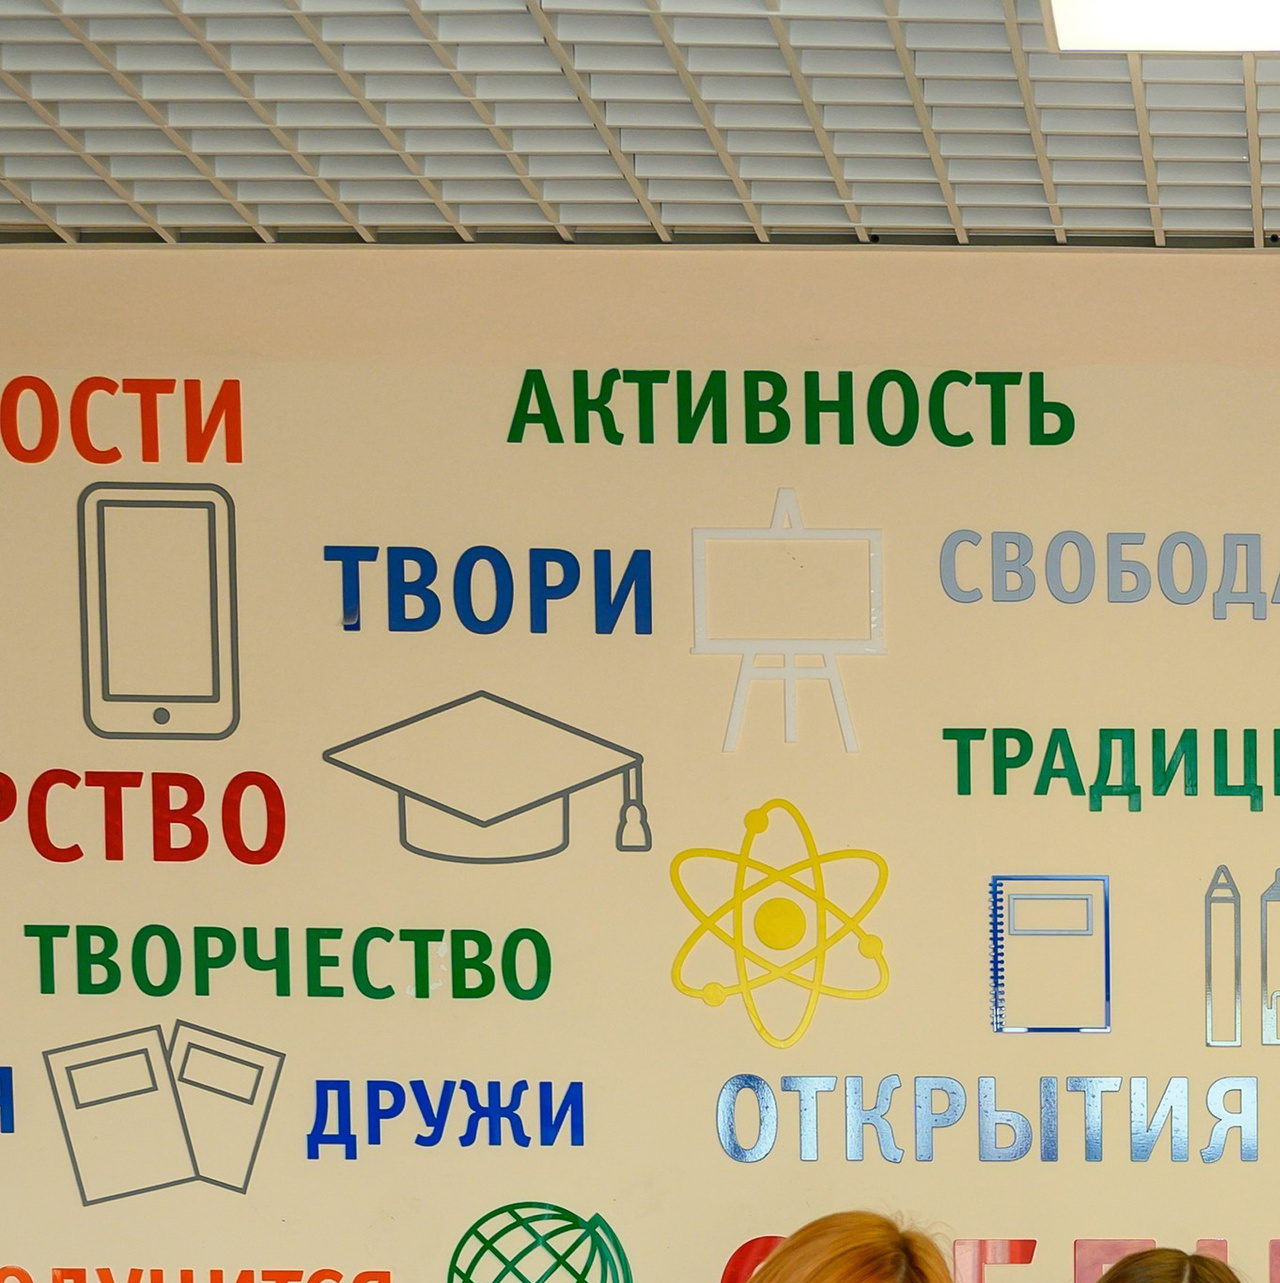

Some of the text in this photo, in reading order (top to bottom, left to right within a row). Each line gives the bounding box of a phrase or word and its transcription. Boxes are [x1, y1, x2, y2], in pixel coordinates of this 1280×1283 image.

[0, 374, 244, 466] ОСТИ
[506, 367, 1076, 449] АКТИВНОСТЬ
[323, 544, 653, 636] ТВОРИ
[0, 767, 287, 866] СТВО
[23, 923, 553, 1002] ТВОРЧЕСТВО
[305, 1078, 586, 1162] ДРУЖИ
[715, 1073, 1259, 1165] ОТКРЫТИЯ
